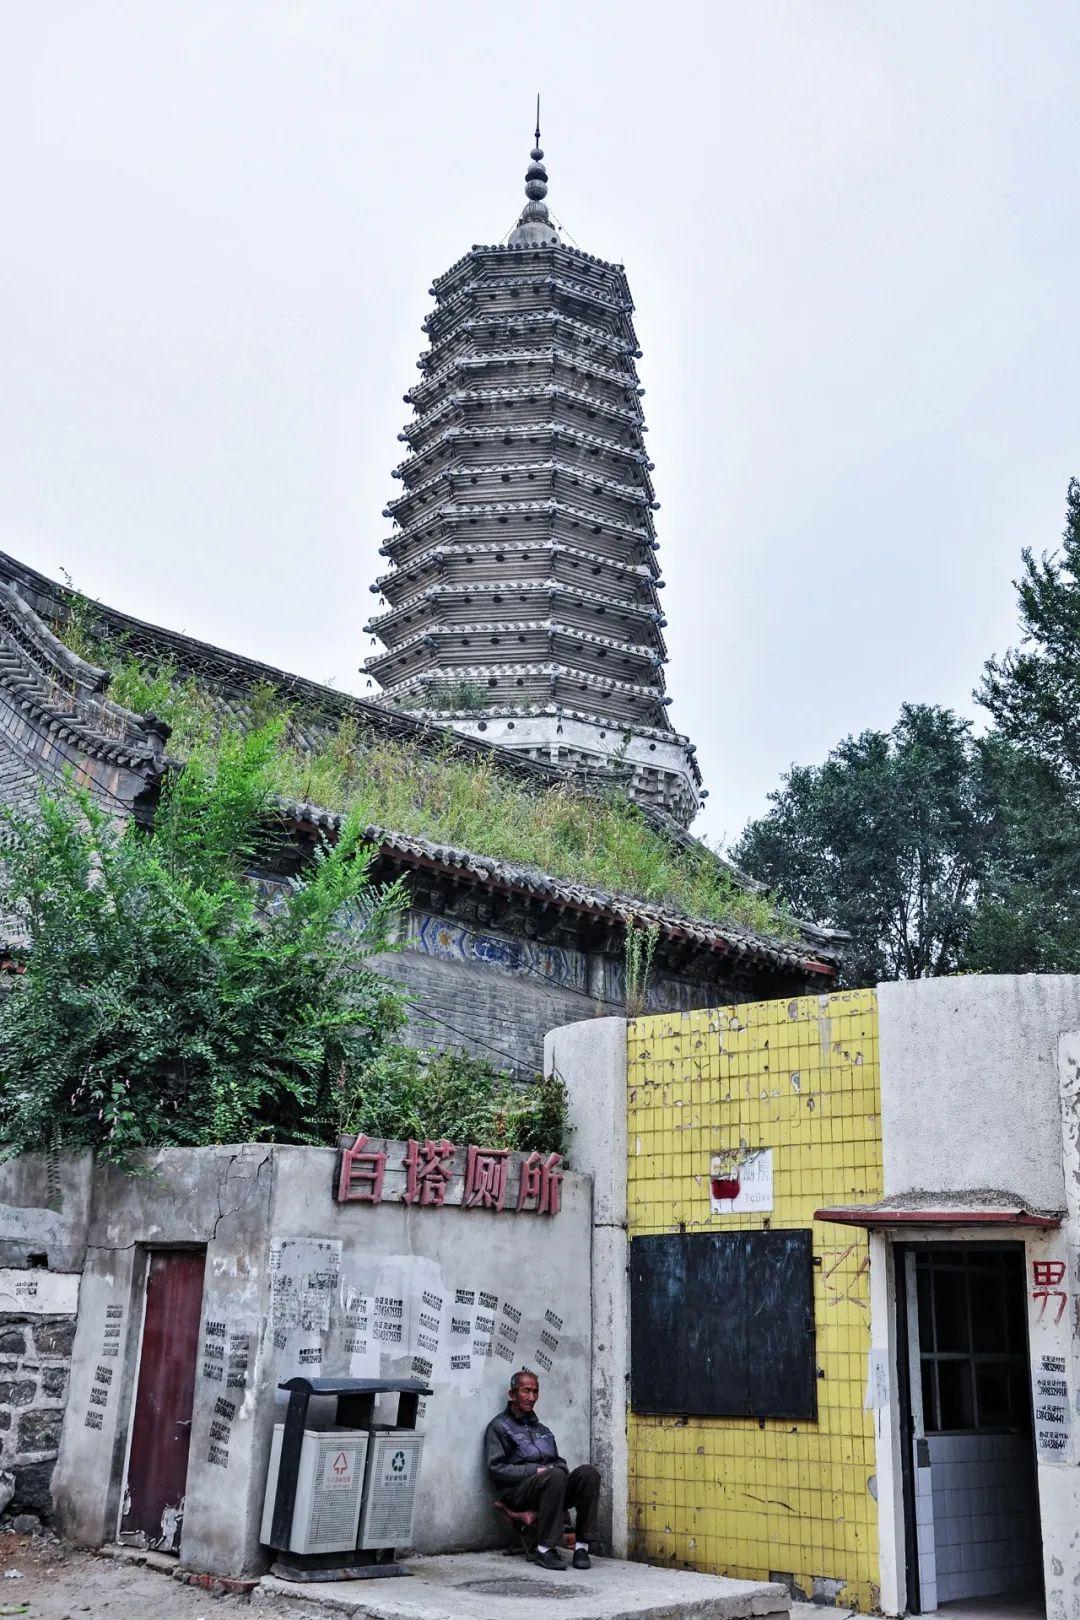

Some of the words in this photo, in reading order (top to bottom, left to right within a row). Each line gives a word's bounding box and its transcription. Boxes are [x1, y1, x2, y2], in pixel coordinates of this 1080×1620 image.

[337, 1133, 563, 1215] 白塔厕所
[1032, 1260, 1068, 1326] 男
